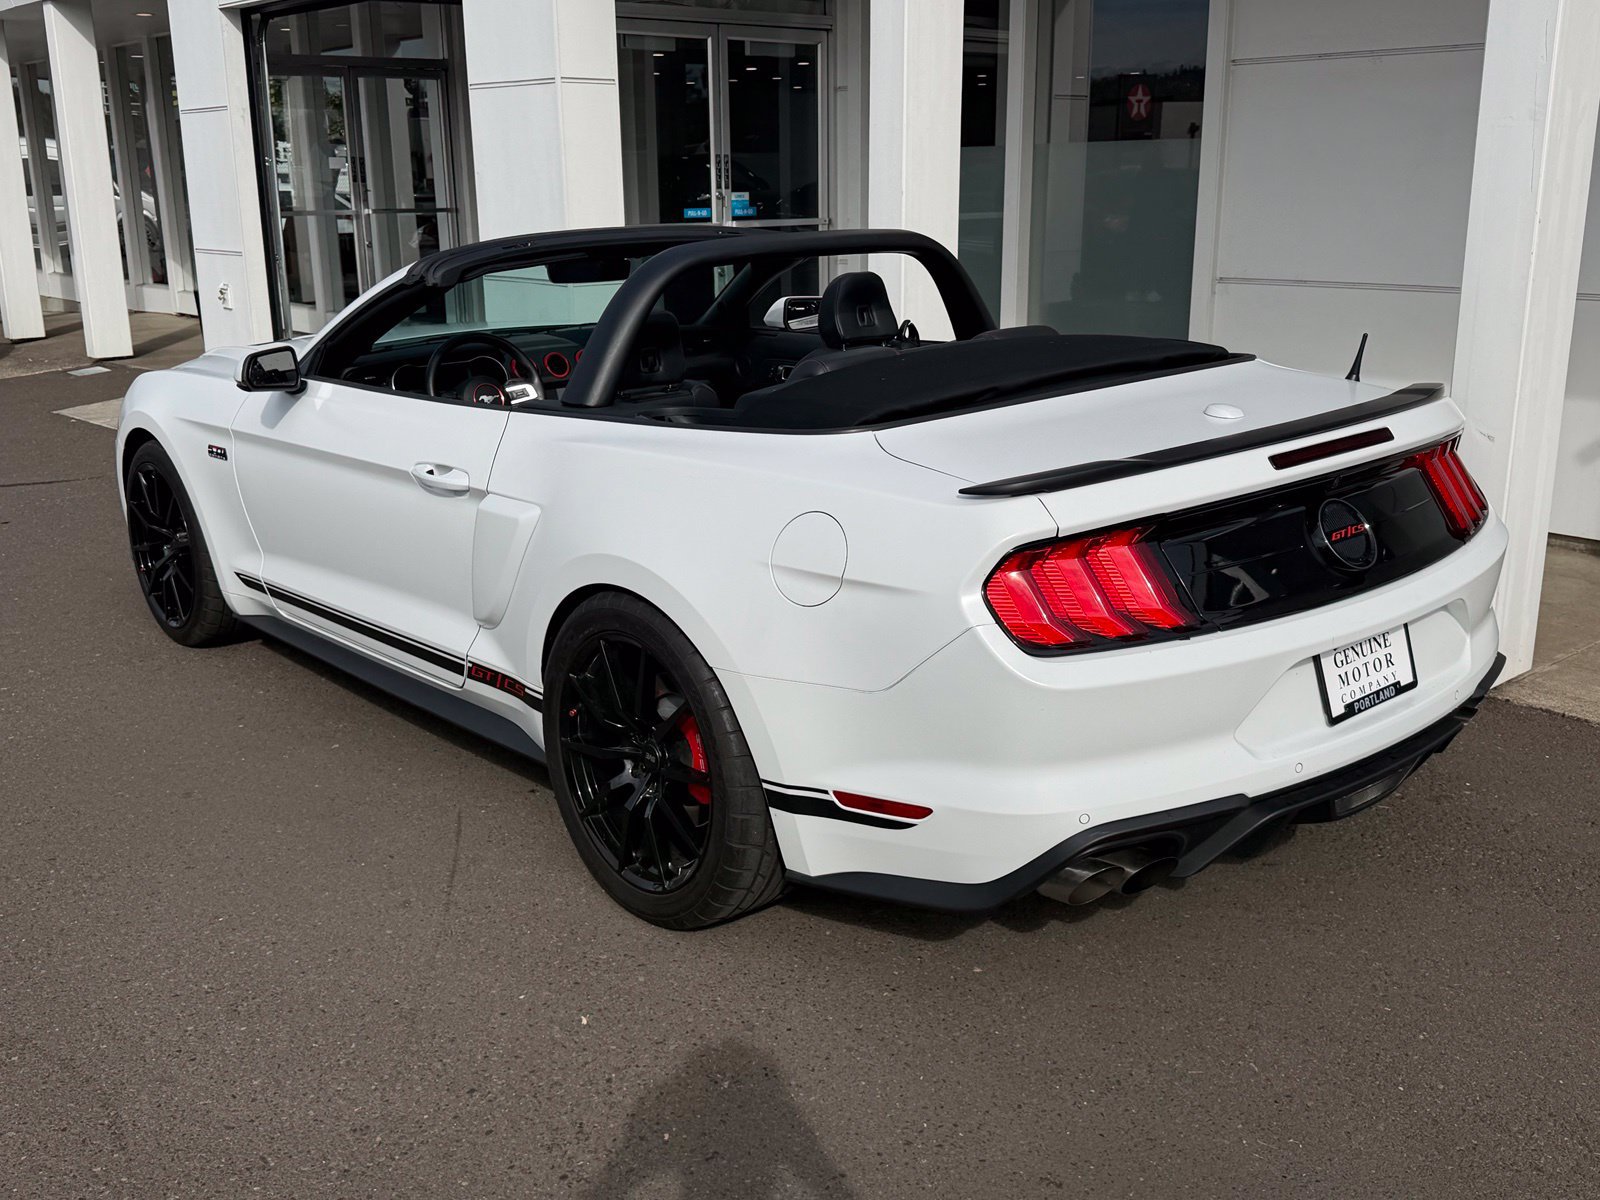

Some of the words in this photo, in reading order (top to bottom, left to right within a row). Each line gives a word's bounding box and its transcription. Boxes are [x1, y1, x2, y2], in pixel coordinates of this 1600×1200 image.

[1333, 631, 1392, 669] GENUINE
[1338, 652, 1395, 689] MOTOR
[1341, 670, 1398, 704] COMPANY
[1353, 686, 1396, 713] PORTLAND
